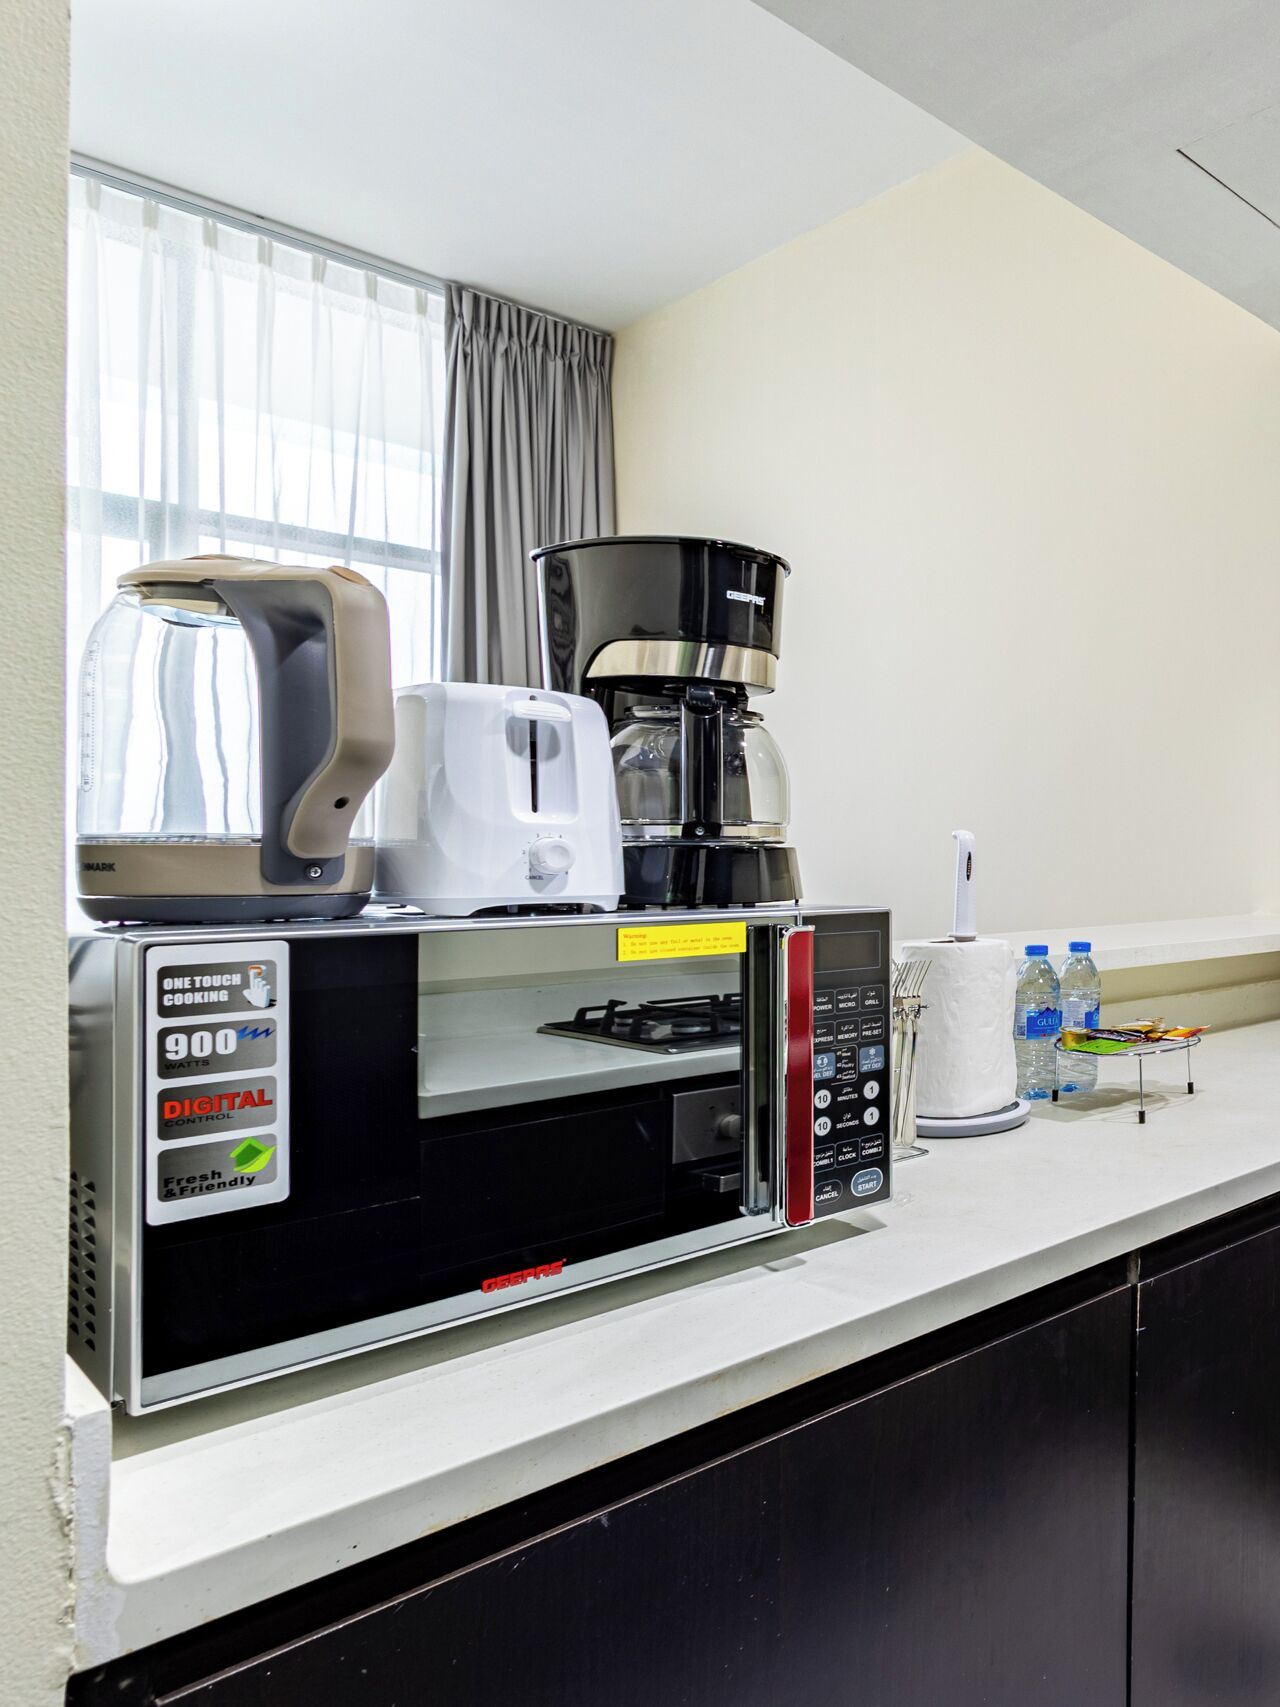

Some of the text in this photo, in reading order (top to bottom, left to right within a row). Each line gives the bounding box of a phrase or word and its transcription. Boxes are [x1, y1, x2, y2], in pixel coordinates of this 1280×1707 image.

[726, 590, 765, 606] GEEPAS
[163, 974, 242, 991] ONE TOUCH
[163, 990, 229, 1007] COOKING
[837, 1032, 858, 1040] MEMORY
[862, 1028, 882, 1036] PRE-SET
[165, 1028, 238, 1061] 900
[814, 1035, 834, 1043] XPRESS
[164, 1059, 210, 1070] WATTS
[837, 1093, 859, 1101] MINUTES
[163, 1089, 273, 1119] DIGITAL
[164, 1113, 234, 1128] CONTROL
[836, 1119, 860, 1129] SECONDS
[838, 1152, 857, 1161] CLOCK
[163, 1169, 222, 1189] Fresh
[857, 1181, 878, 1191] START
[815, 1191, 839, 1202] CANCEL
